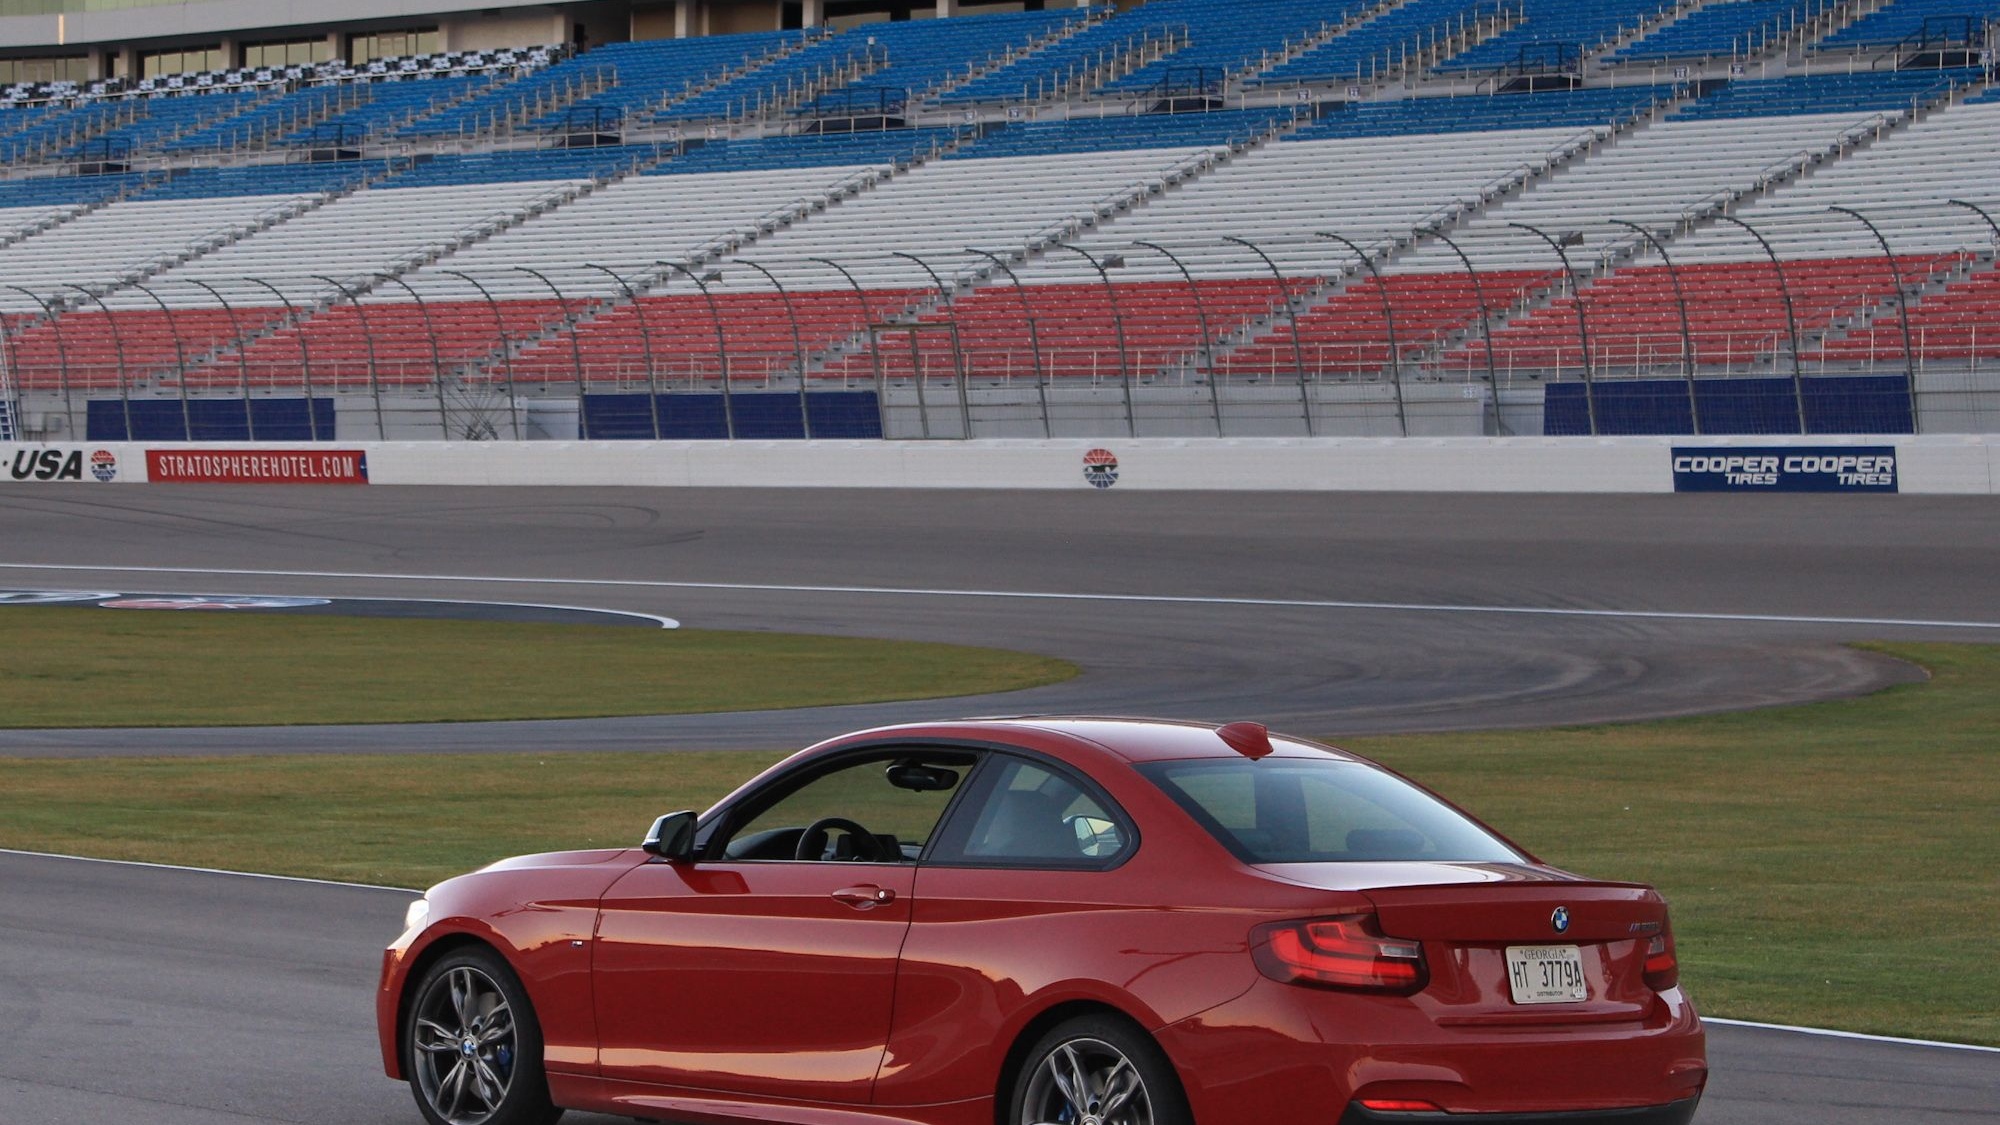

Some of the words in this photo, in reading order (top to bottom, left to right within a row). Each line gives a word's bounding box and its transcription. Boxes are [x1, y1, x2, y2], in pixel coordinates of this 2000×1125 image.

[11, 450, 82, 480] USA
[159, 455, 355, 477] STRATOSPHEREHOTEL.COM
[1674, 456, 1779, 473] COOPER
[1783, 456, 1894, 473] COOPER
[1725, 473, 1778, 485] TIRES
[1837, 473, 1893, 485] TIRES
[1524, 949, 1565, 960] GEORGIA
[1512, 961, 1528, 988] HT
[1539, 960, 1582, 987] 3779A
